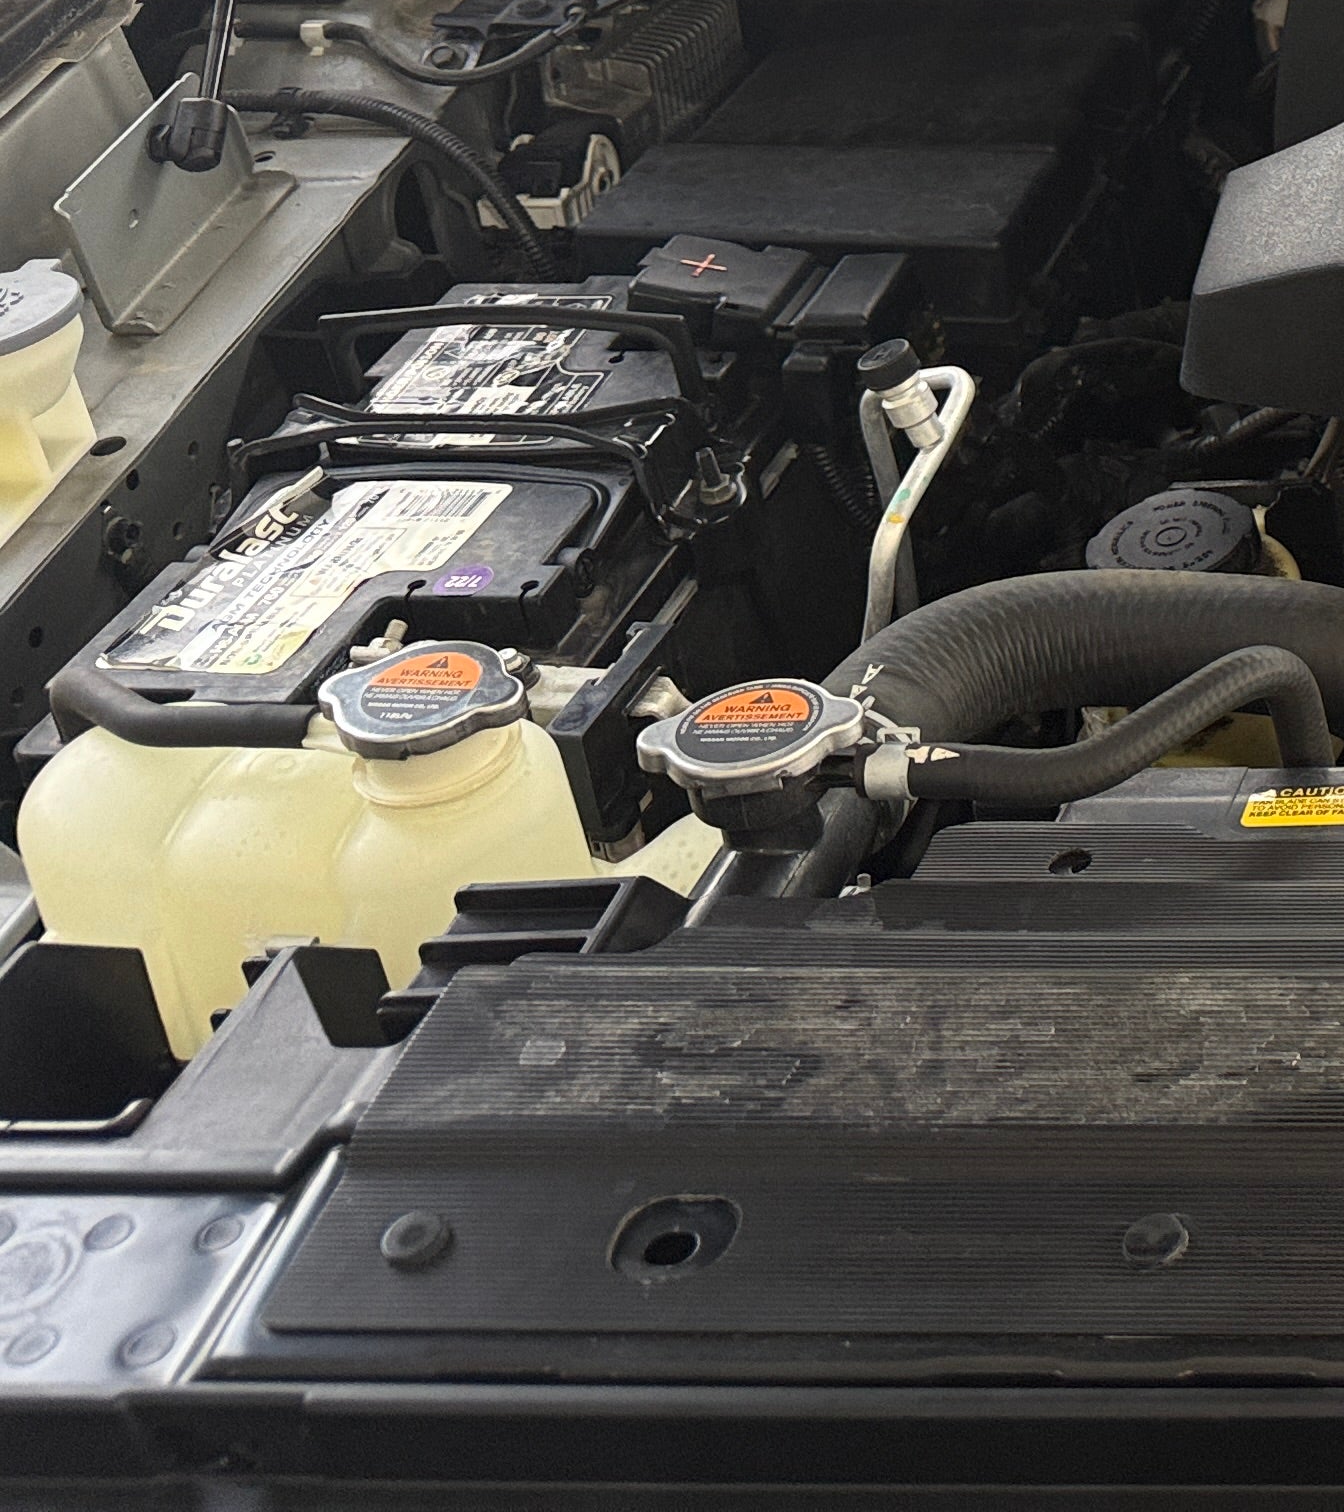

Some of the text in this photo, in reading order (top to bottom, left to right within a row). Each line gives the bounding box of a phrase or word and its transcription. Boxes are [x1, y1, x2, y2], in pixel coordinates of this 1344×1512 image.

[231, 513, 314, 588] PLATINUM
[248, 518, 330, 601] TECHNOLOGY
[139, 498, 299, 635] Duralast
[400, 669, 464, 679] WARNING
[376, 677, 473, 687] AVERTISSEMENT
[724, 703, 793, 713] WARNING
[702, 712, 804, 721] AVERTISSEMENT
